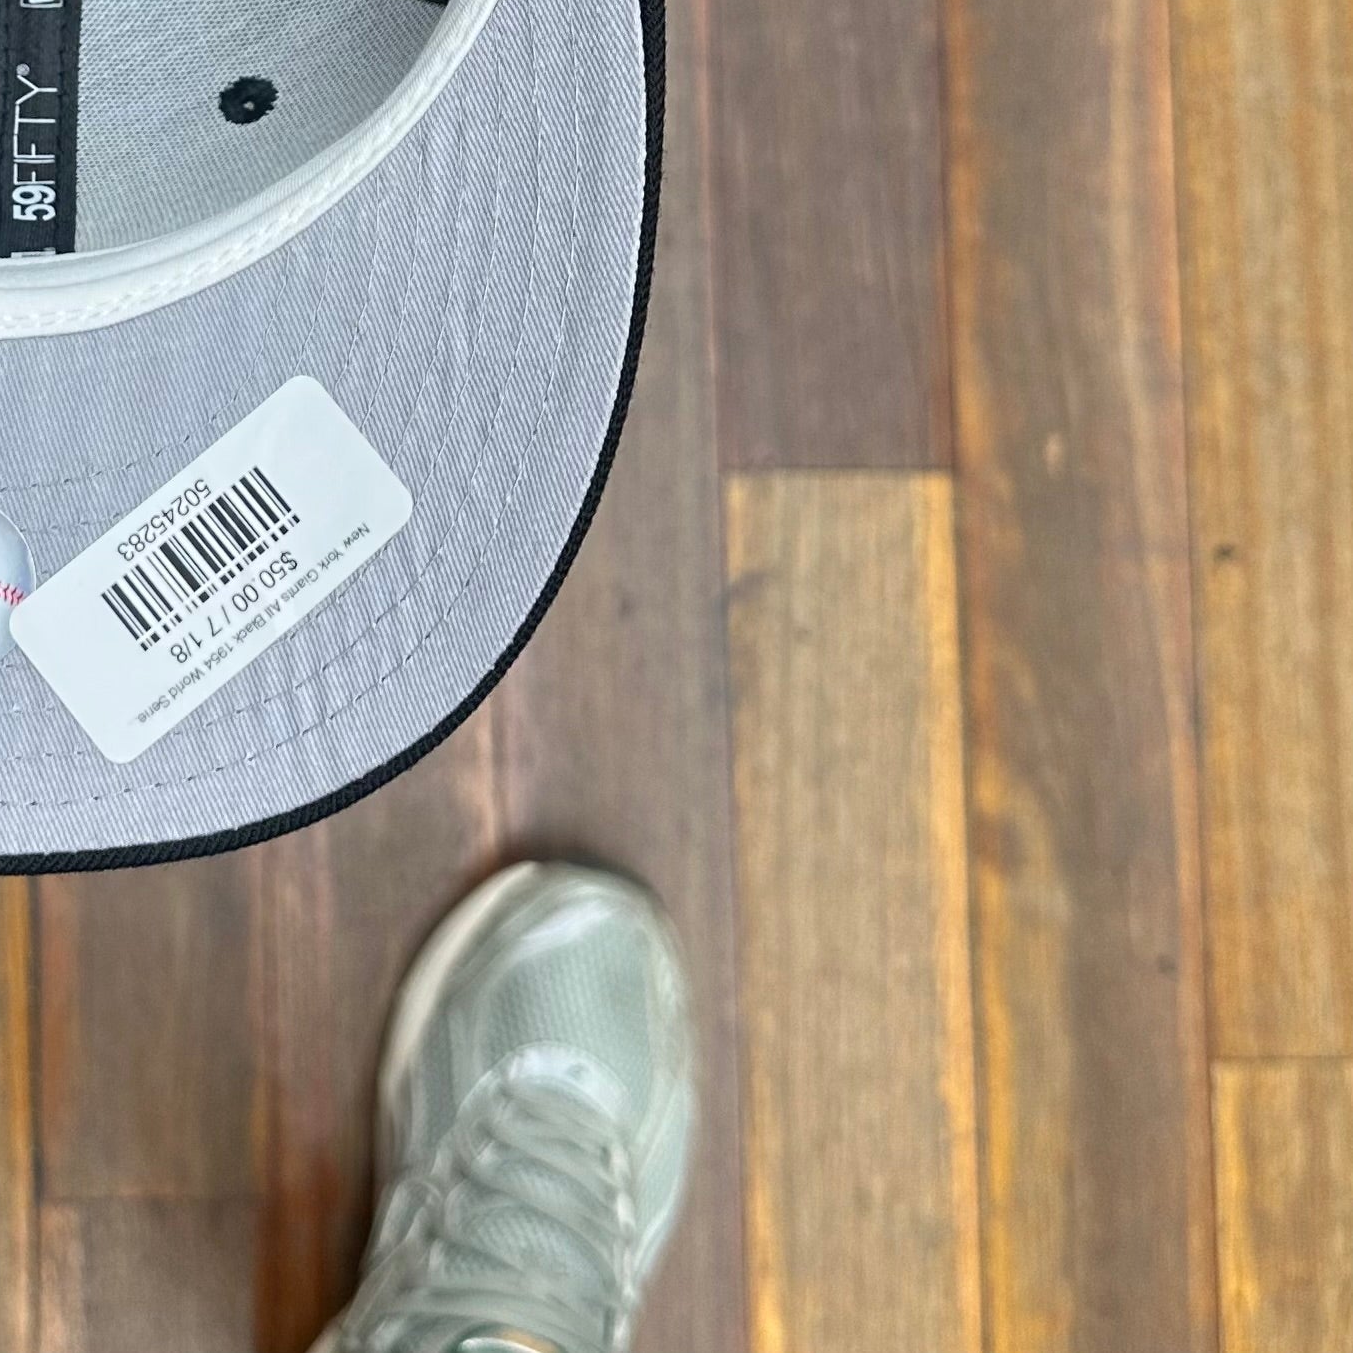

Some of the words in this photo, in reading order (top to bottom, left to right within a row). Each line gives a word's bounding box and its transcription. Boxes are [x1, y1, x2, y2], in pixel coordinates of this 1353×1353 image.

[12, 75, 58, 221] 59FIFTY
[117, 479, 211, 561] 50245283
[343, 522, 371, 550] New
[318, 550, 345, 571] York
[231, 550, 298, 613] $50.00
[280, 568, 319, 603] Giants
[264, 599, 282, 617] All
[207, 615, 223, 637] 7
[234, 613, 267, 644] Black
[170, 631, 203, 664] 1/8
[203, 642, 235, 671] 1954
[168, 667, 206, 701] World
